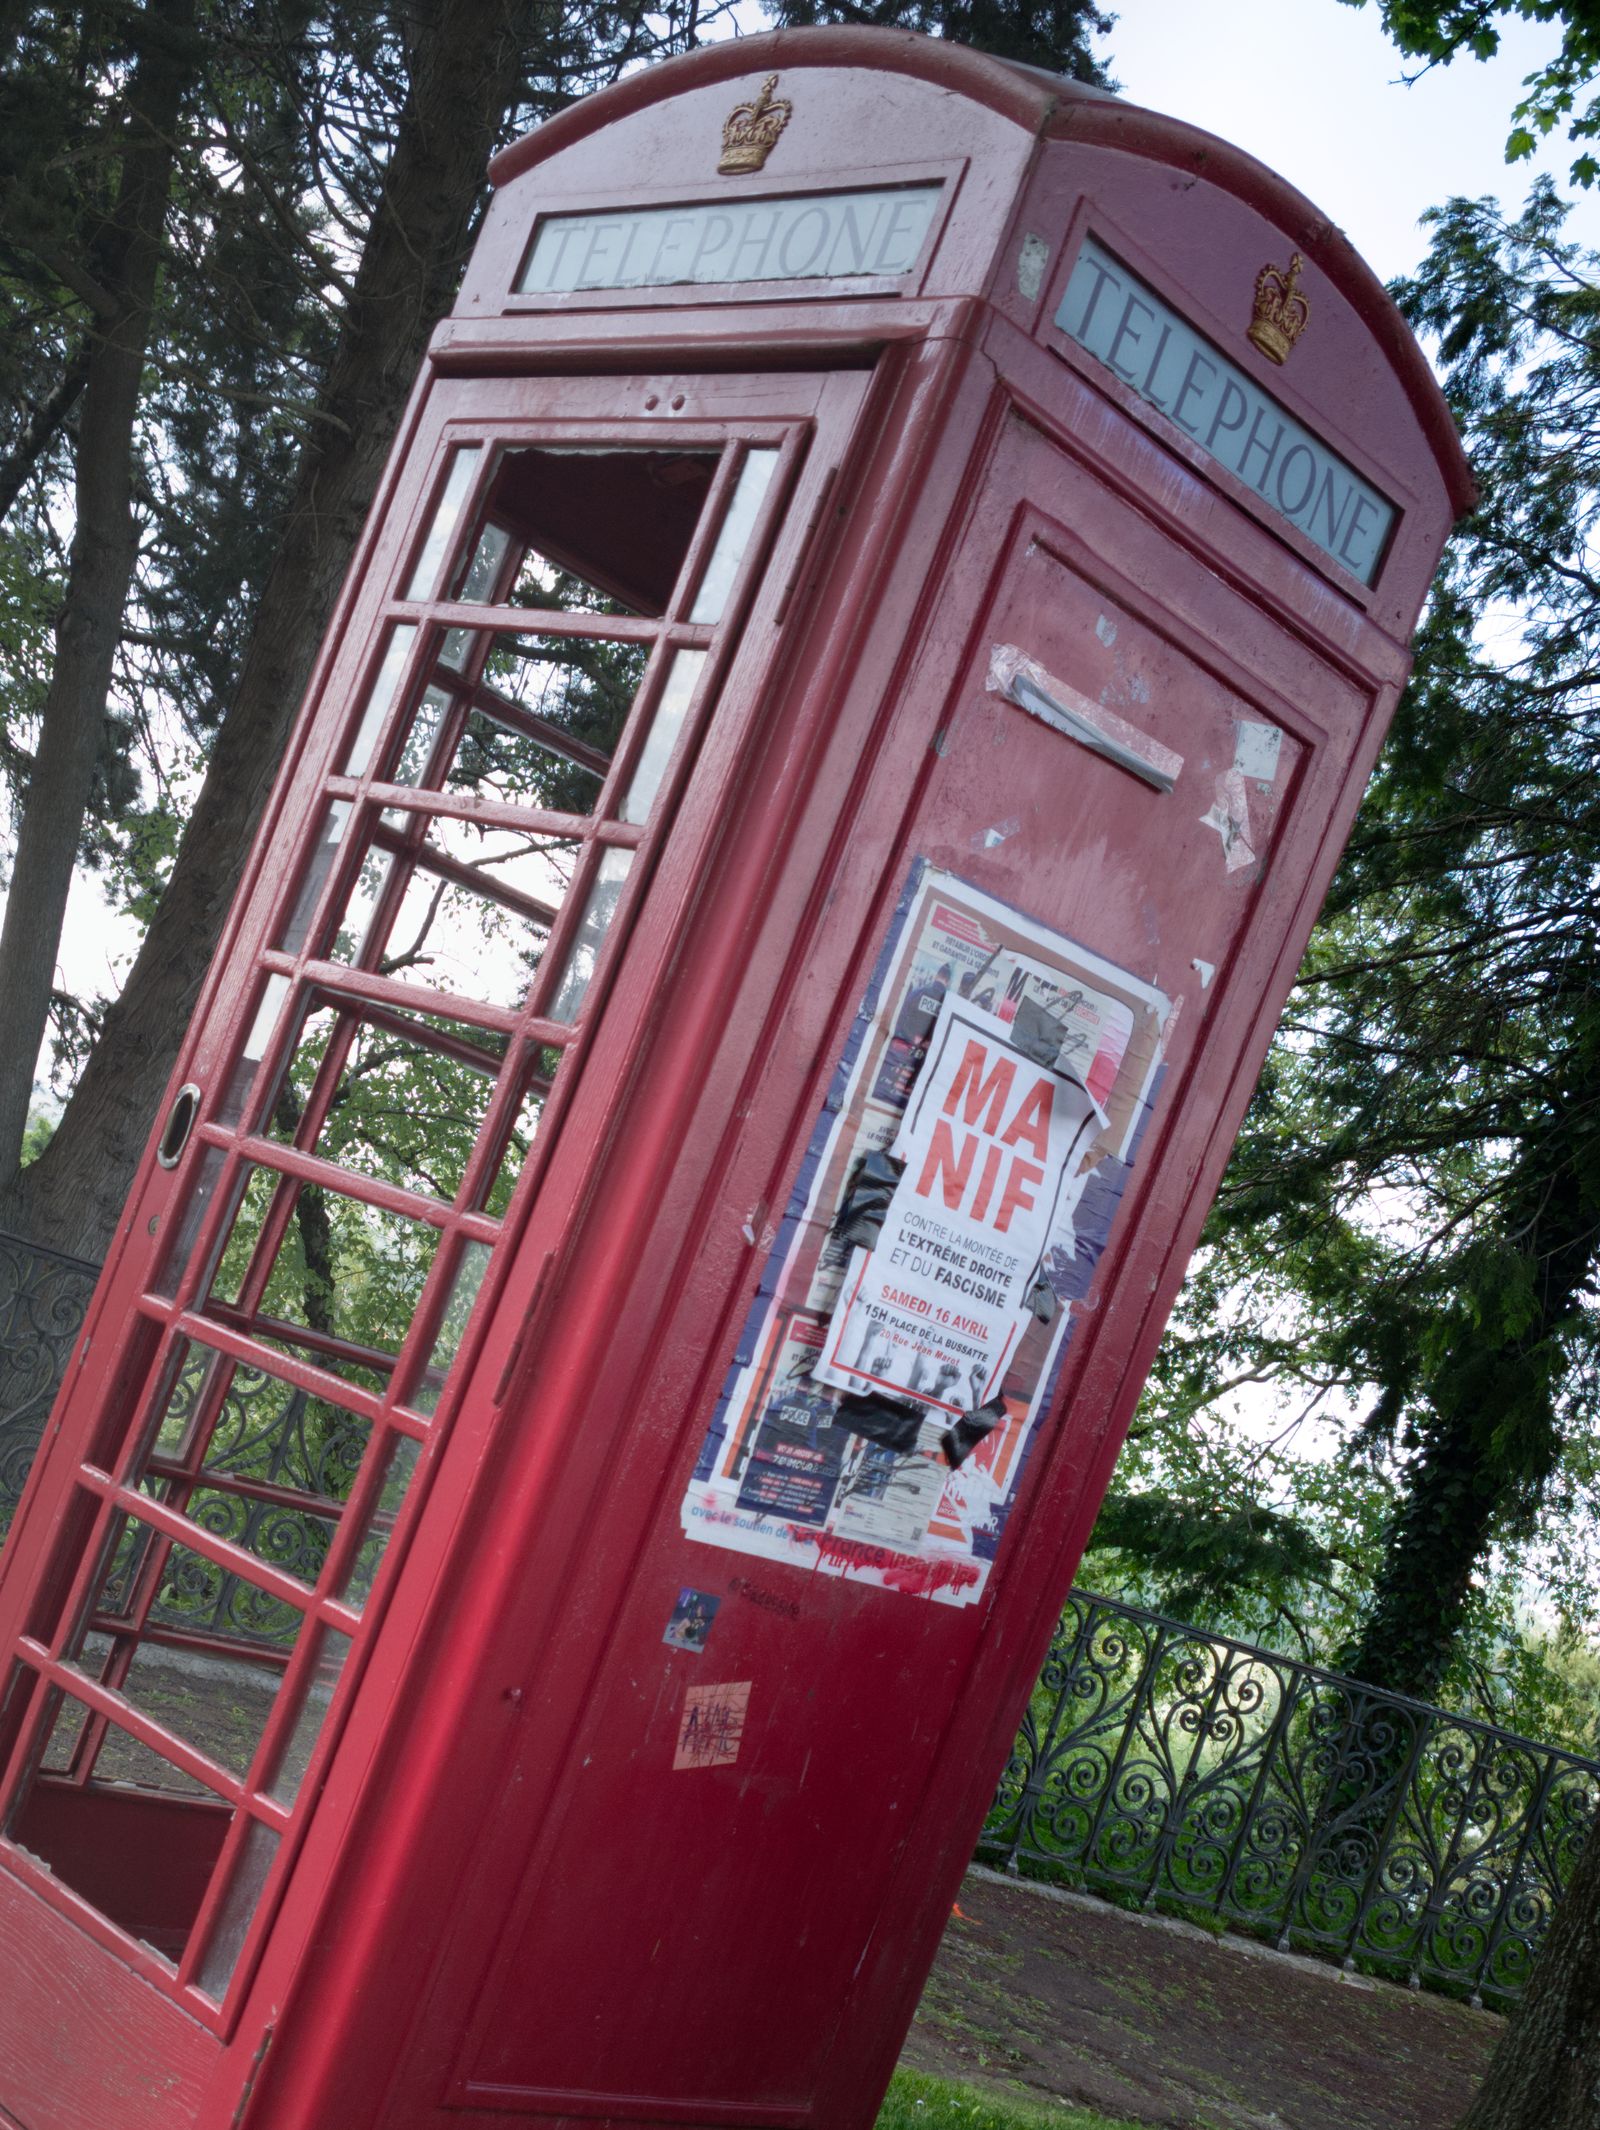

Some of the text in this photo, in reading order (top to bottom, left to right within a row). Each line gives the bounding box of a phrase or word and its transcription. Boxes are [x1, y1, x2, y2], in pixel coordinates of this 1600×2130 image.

[545, 200, 928, 287] TELEPHONE
[1077, 257, 1380, 570] TELEPHONE
[942, 1039, 1056, 1164] MA
[915, 1118, 1045, 1233] NIF
[898, 1229, 1013, 1288] L'EXTRÊME DROITE
[904, 1211, 1019, 1272] CONTRE LA MONTÉE DE
[889, 1247, 1007, 1309] ET DU FASCISME
[865, 1303, 989, 1363] 15H PLACE DE LA BUSSATTE
[881, 1285, 989, 1340] SAMEDI 16 AVRIL
[879, 1328, 961, 1367] 20 Rue Jean Marot
[691, 1506, 719, 1522] avec
[720, 1511, 733, 1525] le
[733, 1517, 773, 1536] soutien
[775, 1524, 788, 1539] de
